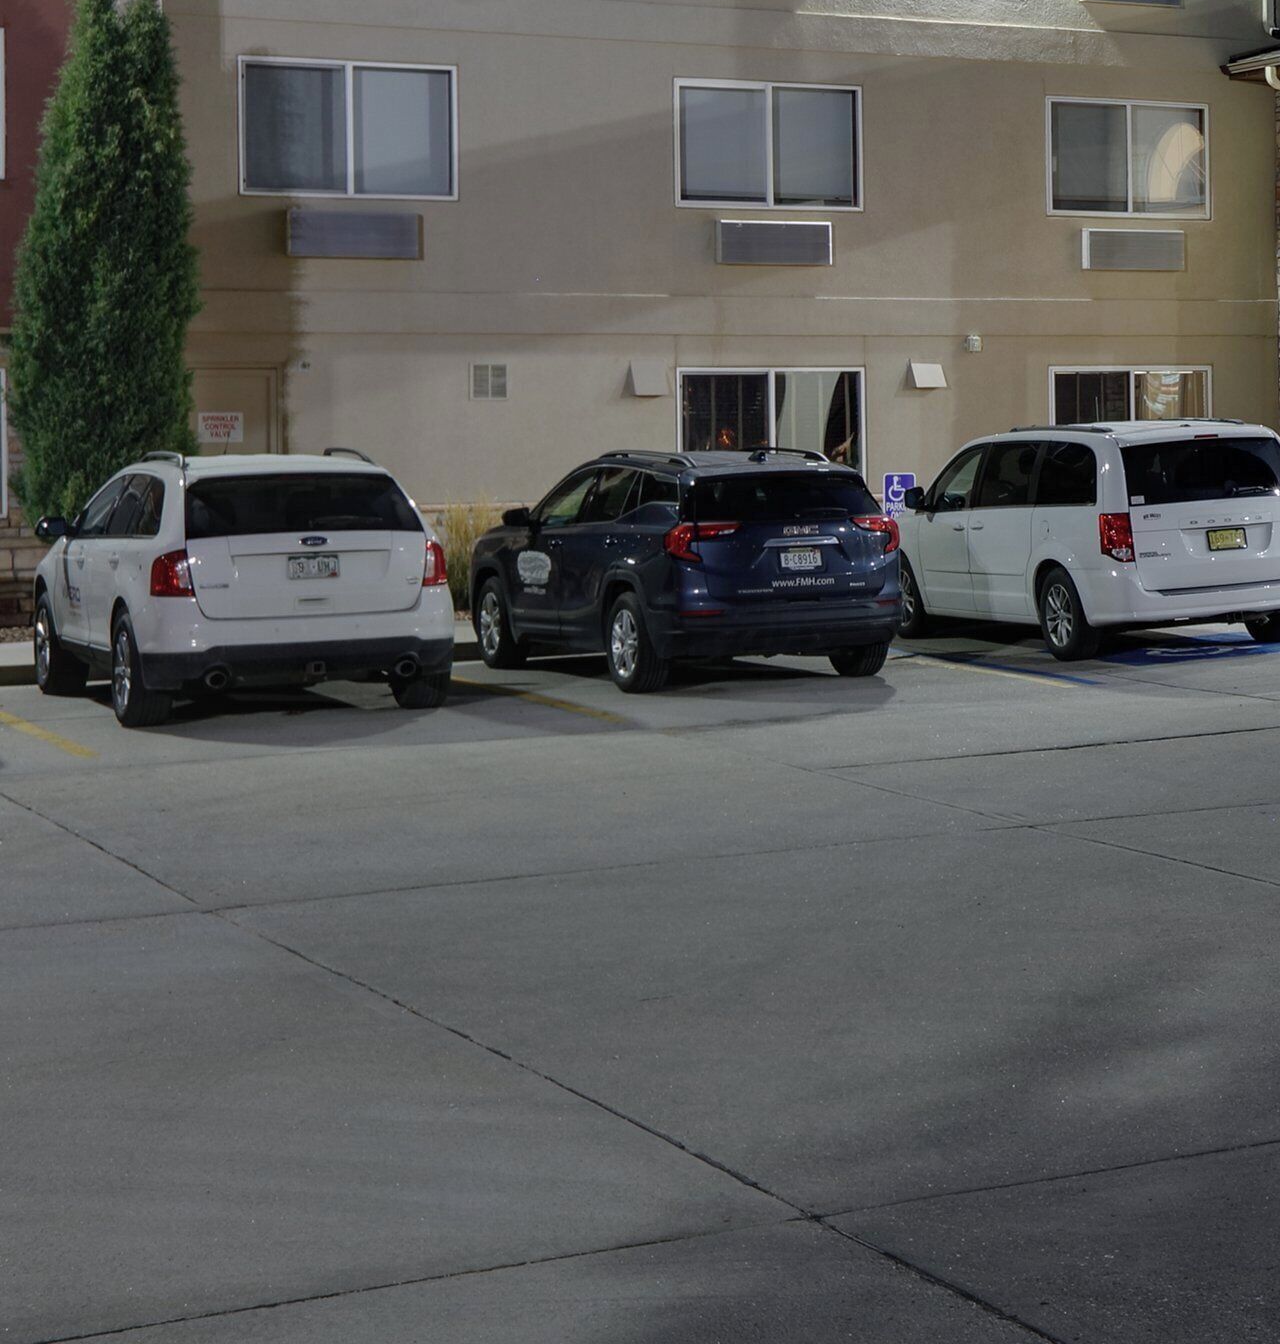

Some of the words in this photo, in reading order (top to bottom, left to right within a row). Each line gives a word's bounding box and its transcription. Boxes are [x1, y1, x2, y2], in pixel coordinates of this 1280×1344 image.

[202, 415, 240, 423] SPRINKLER
[204, 423, 236, 431] CONTROL
[783, 525, 819, 536] GMC
[772, 577, 835, 587] www.FMH.com
